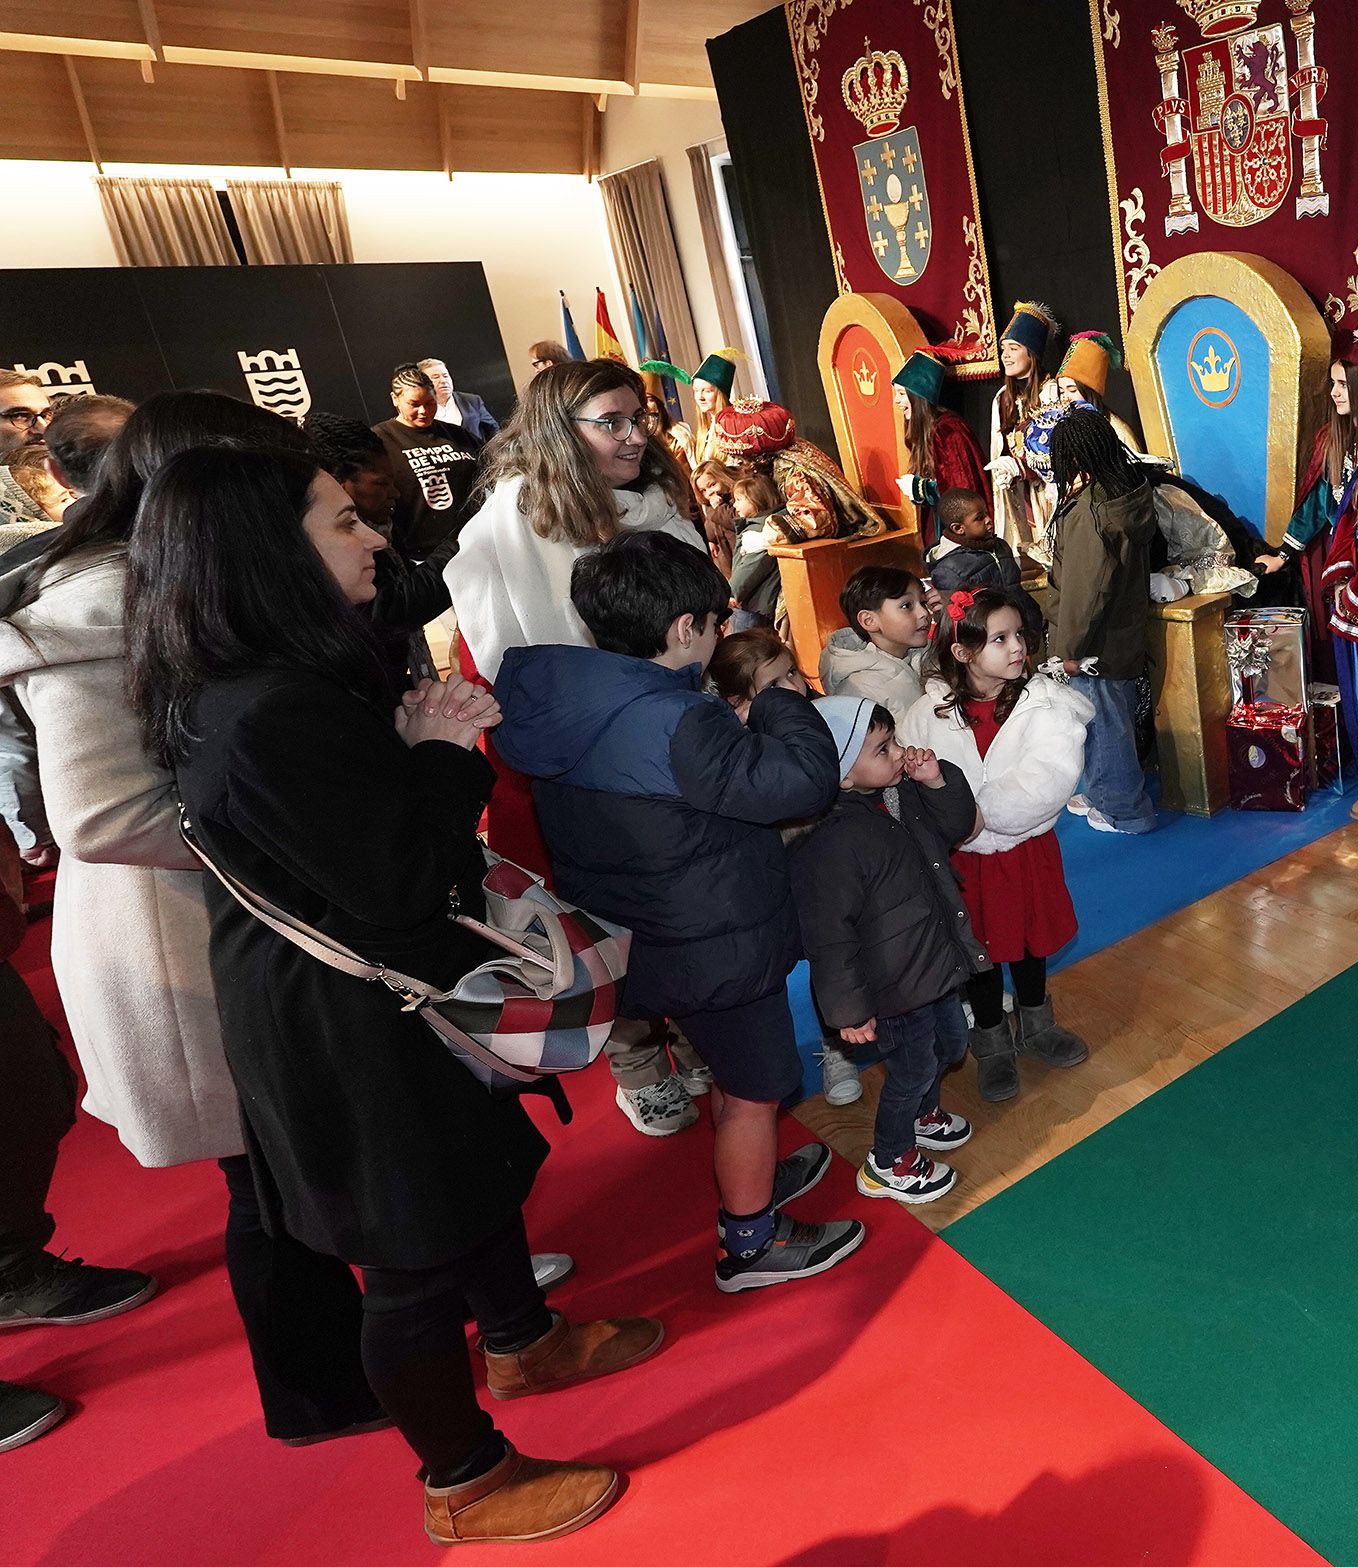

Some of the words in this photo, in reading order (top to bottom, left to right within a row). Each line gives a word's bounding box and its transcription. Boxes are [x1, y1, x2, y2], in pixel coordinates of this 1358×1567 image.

[1157, 100, 1186, 119] PLVS
[402, 444, 454, 459] TEMPO
[408, 456, 431, 470] DE
[430, 451, 476, 464] NADAL
